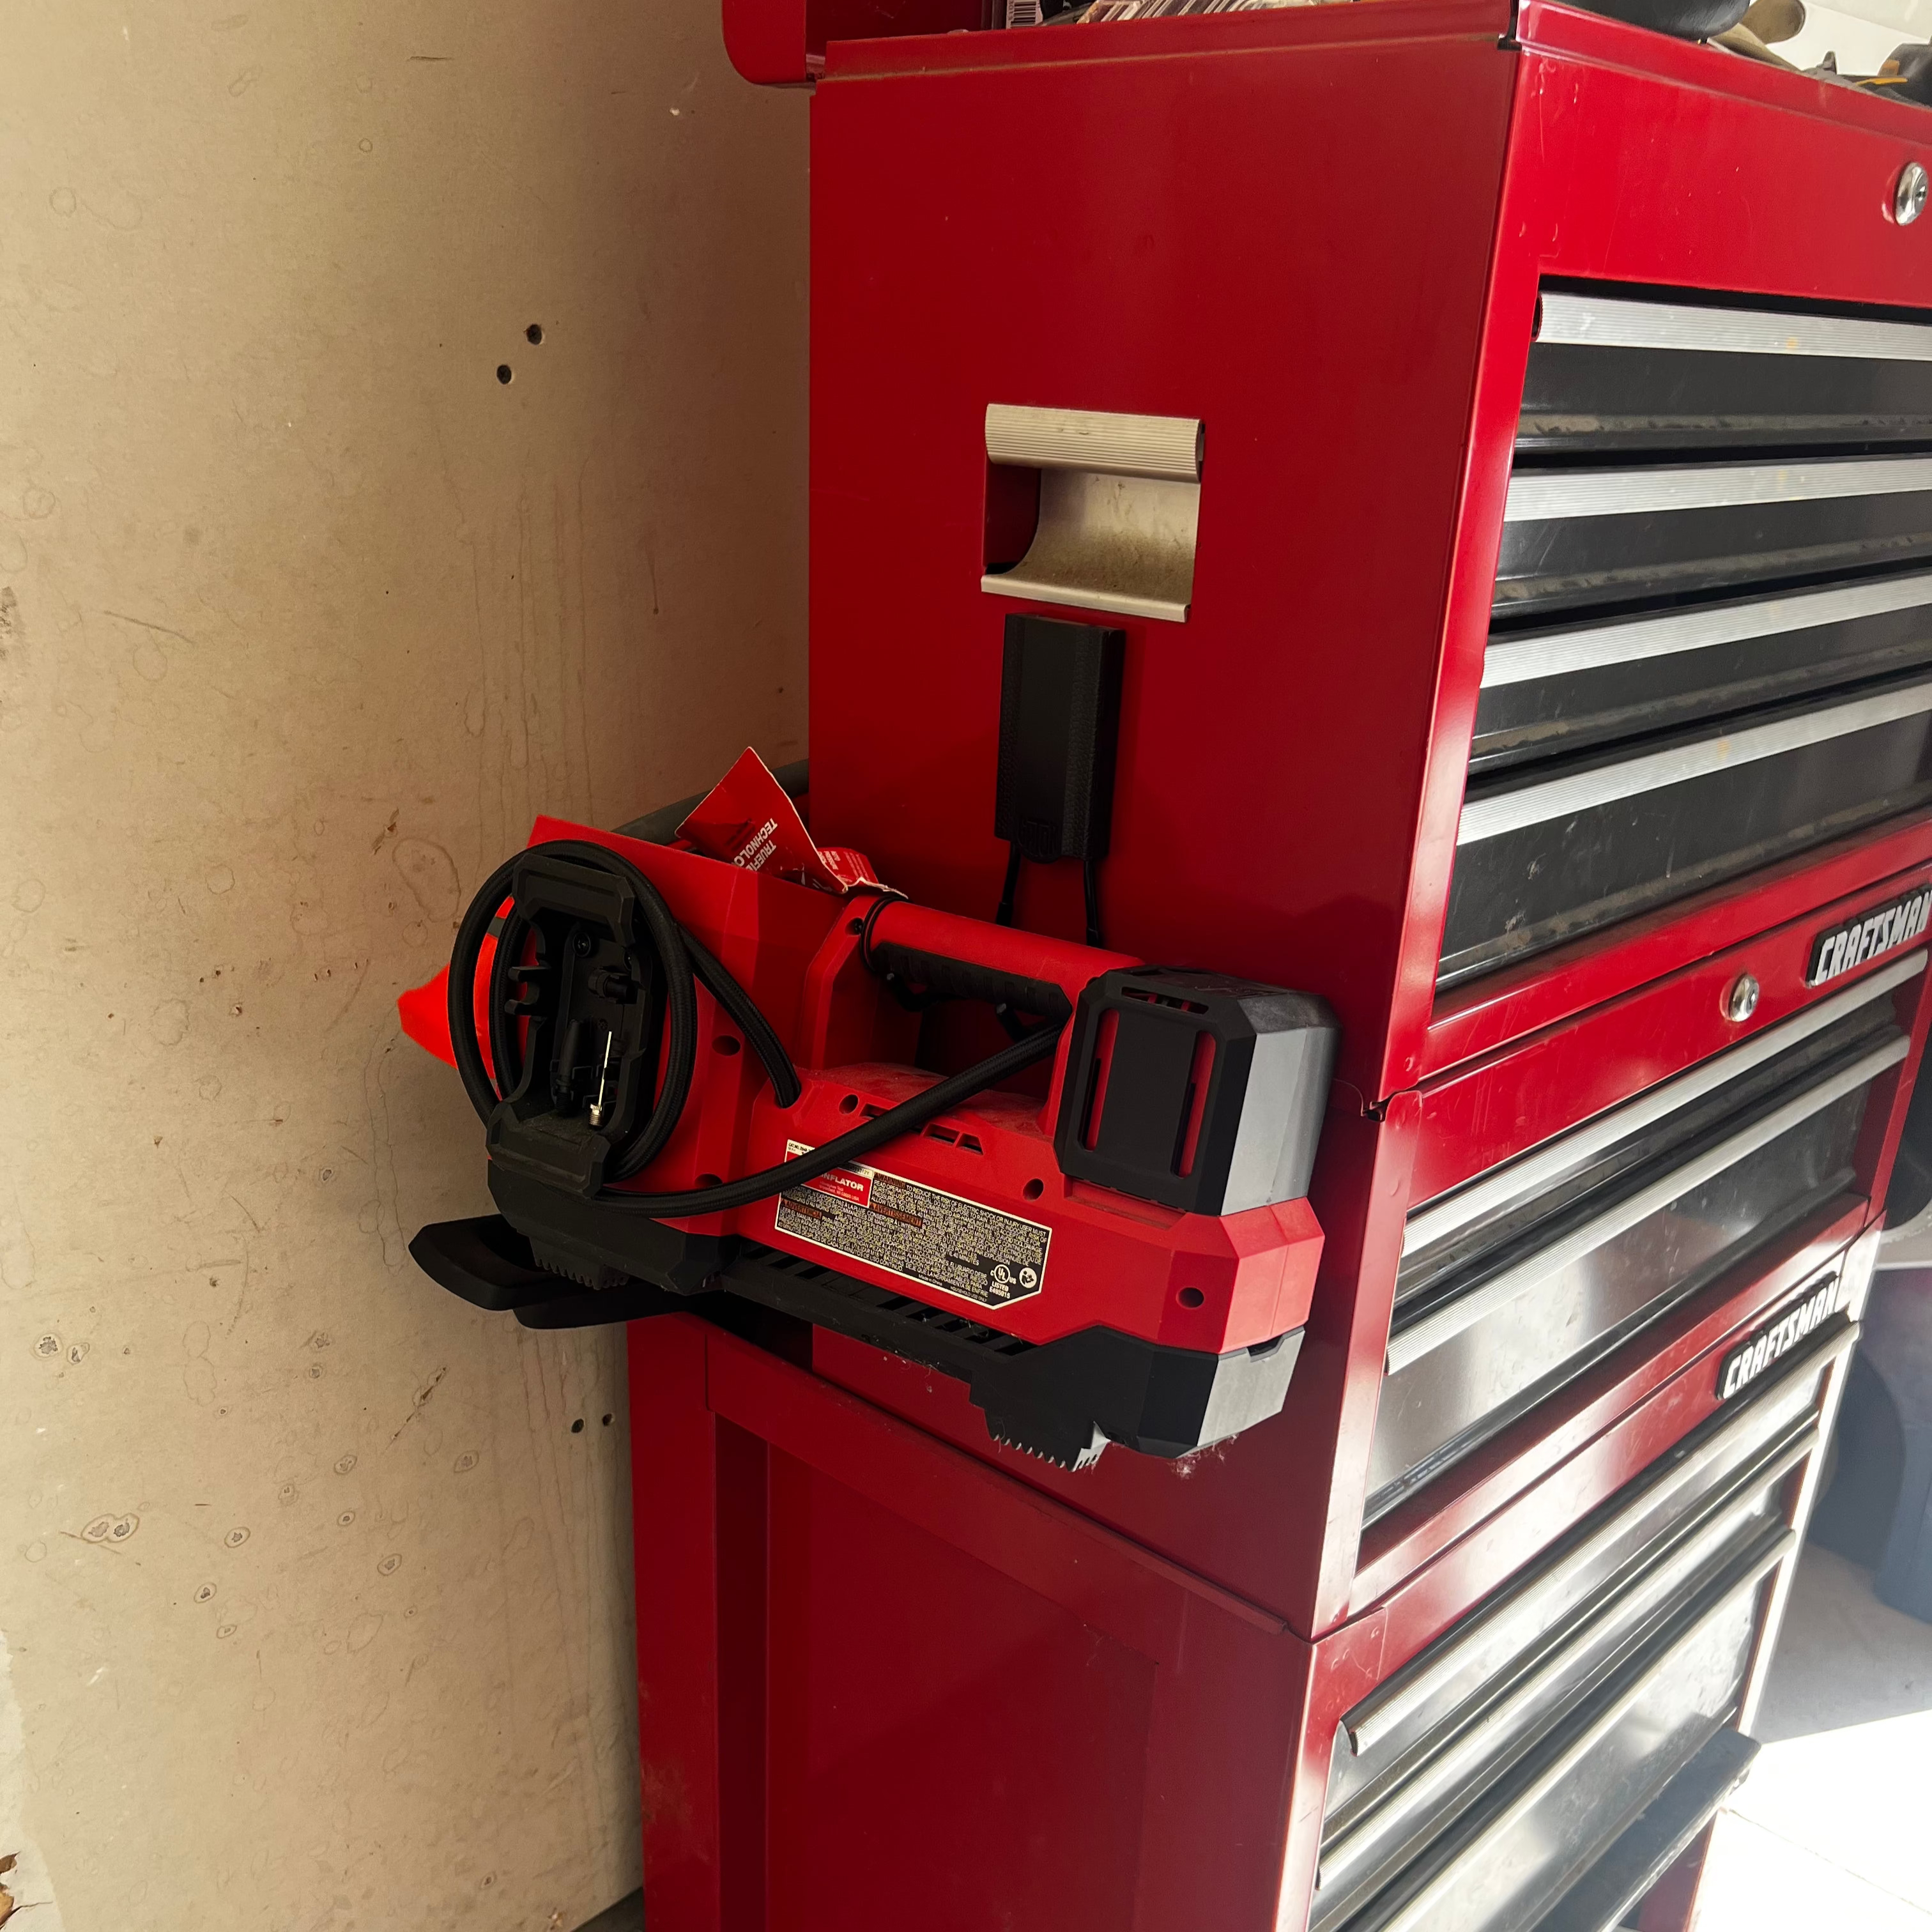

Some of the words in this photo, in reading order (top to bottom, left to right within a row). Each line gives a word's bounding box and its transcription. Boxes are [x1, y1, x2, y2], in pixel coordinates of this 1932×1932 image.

[1815, 889, 1932, 986] CRAFTSMAN
[912, 1187, 931, 1198] REDUCE
[992, 1281, 1009, 1291] LISTED
[1723, 1280, 1839, 1399] CRAFTSMAN
